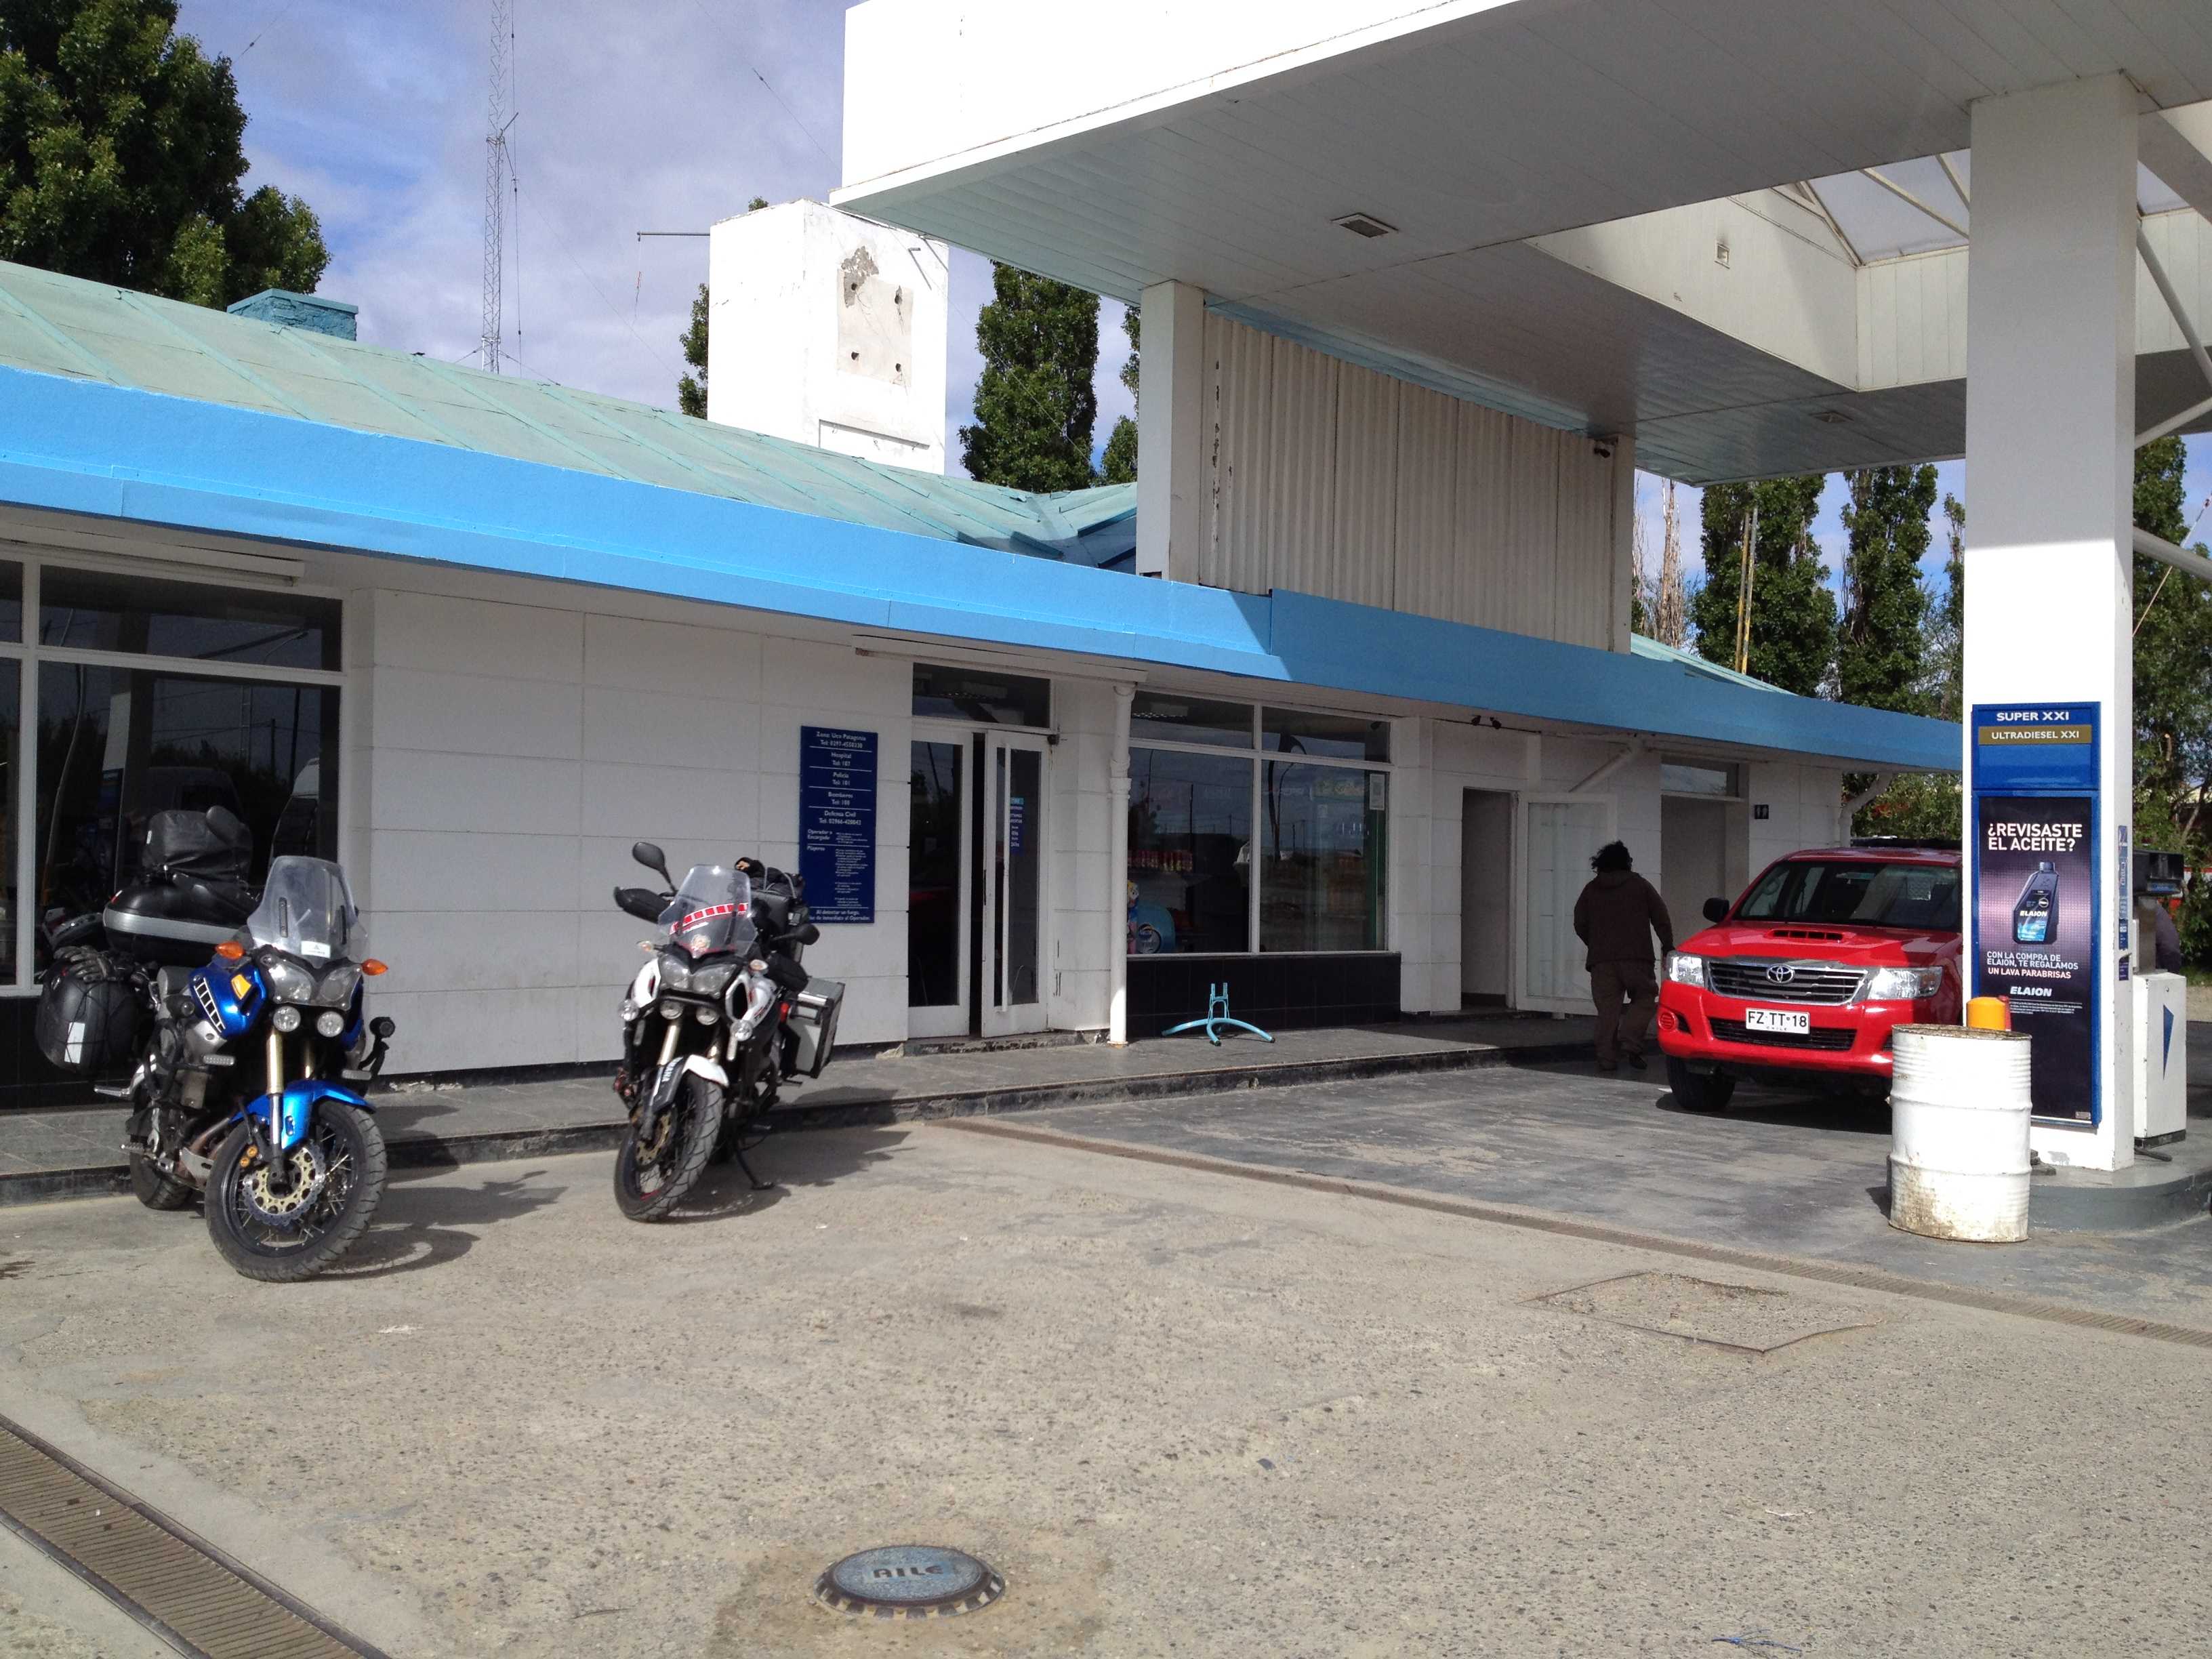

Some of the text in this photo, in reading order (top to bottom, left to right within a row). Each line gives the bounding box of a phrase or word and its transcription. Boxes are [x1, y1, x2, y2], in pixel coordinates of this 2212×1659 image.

[1996, 712, 2070, 721] SUPER XXI
[1991, 731, 2080, 739] ULTRADIESEL XXI
[1988, 823, 2083, 838] ¿REVISASTE
[1988, 838, 2076, 852] EL ACEITE?
[1987, 951, 2003, 959] CON
[2015, 953, 2049, 961] COMPRA
[1987, 958, 2017, 967] ELAION,
[2030, 960, 2078, 970] REGALAMOS
[2021, 969, 2072, 979] PARABRISAS
[2010, 986, 2052, 997] ELAION
